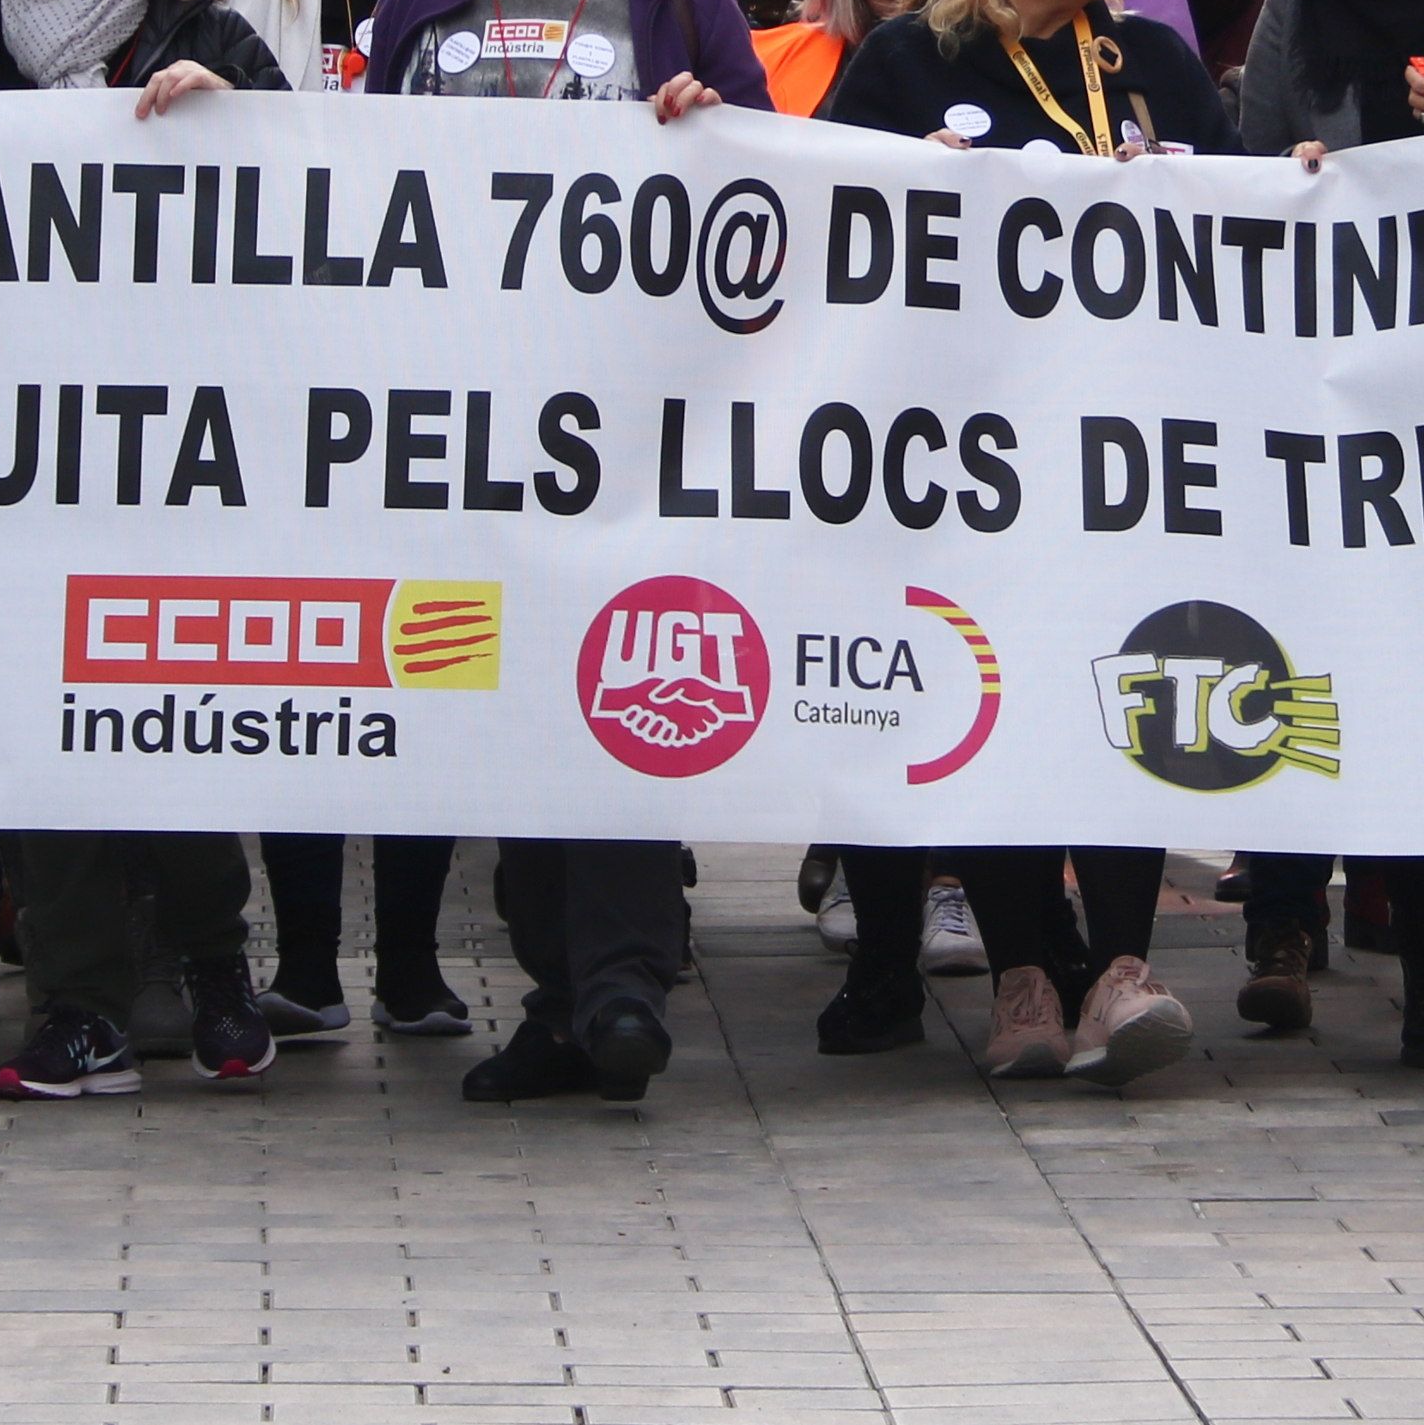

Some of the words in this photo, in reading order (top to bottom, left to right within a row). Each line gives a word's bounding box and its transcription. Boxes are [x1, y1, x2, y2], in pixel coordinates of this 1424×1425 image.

[484, 41, 545, 54] indústria
[491, 25, 540, 38] CCOO
[492, 173, 788, 335] 760@
[827, 186, 961, 310] DE
[305, 388, 600, 515] PELS
[659, 398, 1021, 532] LLOCS
[1081, 417, 1223, 537] DE
[86, 598, 361, 663] CCOO
[601, 610, 744, 683] UGT
[795, 633, 924, 693] FICA
[62, 692, 397, 758] indústria
[794, 700, 902, 732] Catalunya
[1092, 652, 1280, 752] FTC
